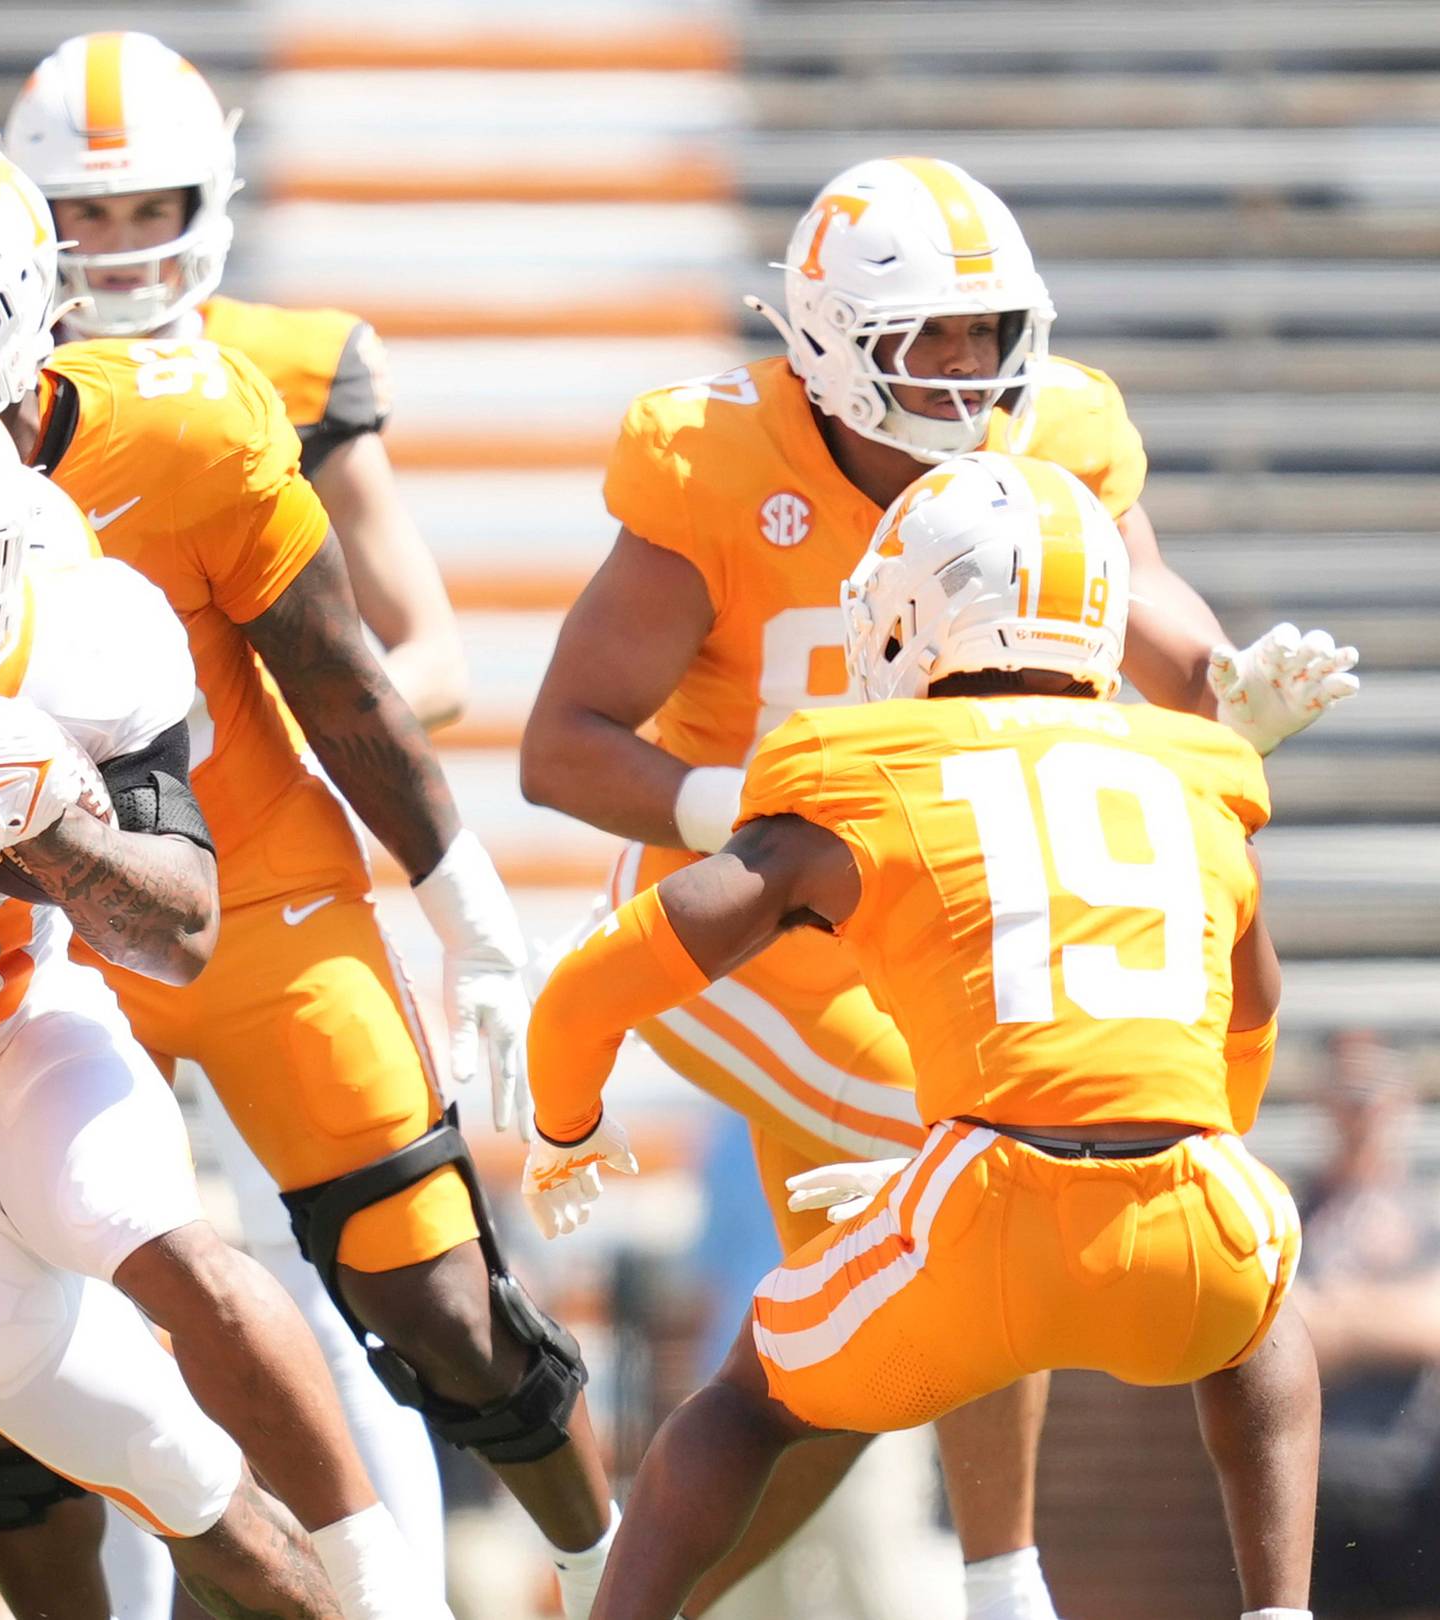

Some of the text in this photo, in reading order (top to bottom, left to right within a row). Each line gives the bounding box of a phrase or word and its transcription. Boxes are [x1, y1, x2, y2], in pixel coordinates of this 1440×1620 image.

[800, 194, 870, 280] T
[760, 493, 810, 547] SEC
[940, 741, 1210, 1025] 19
